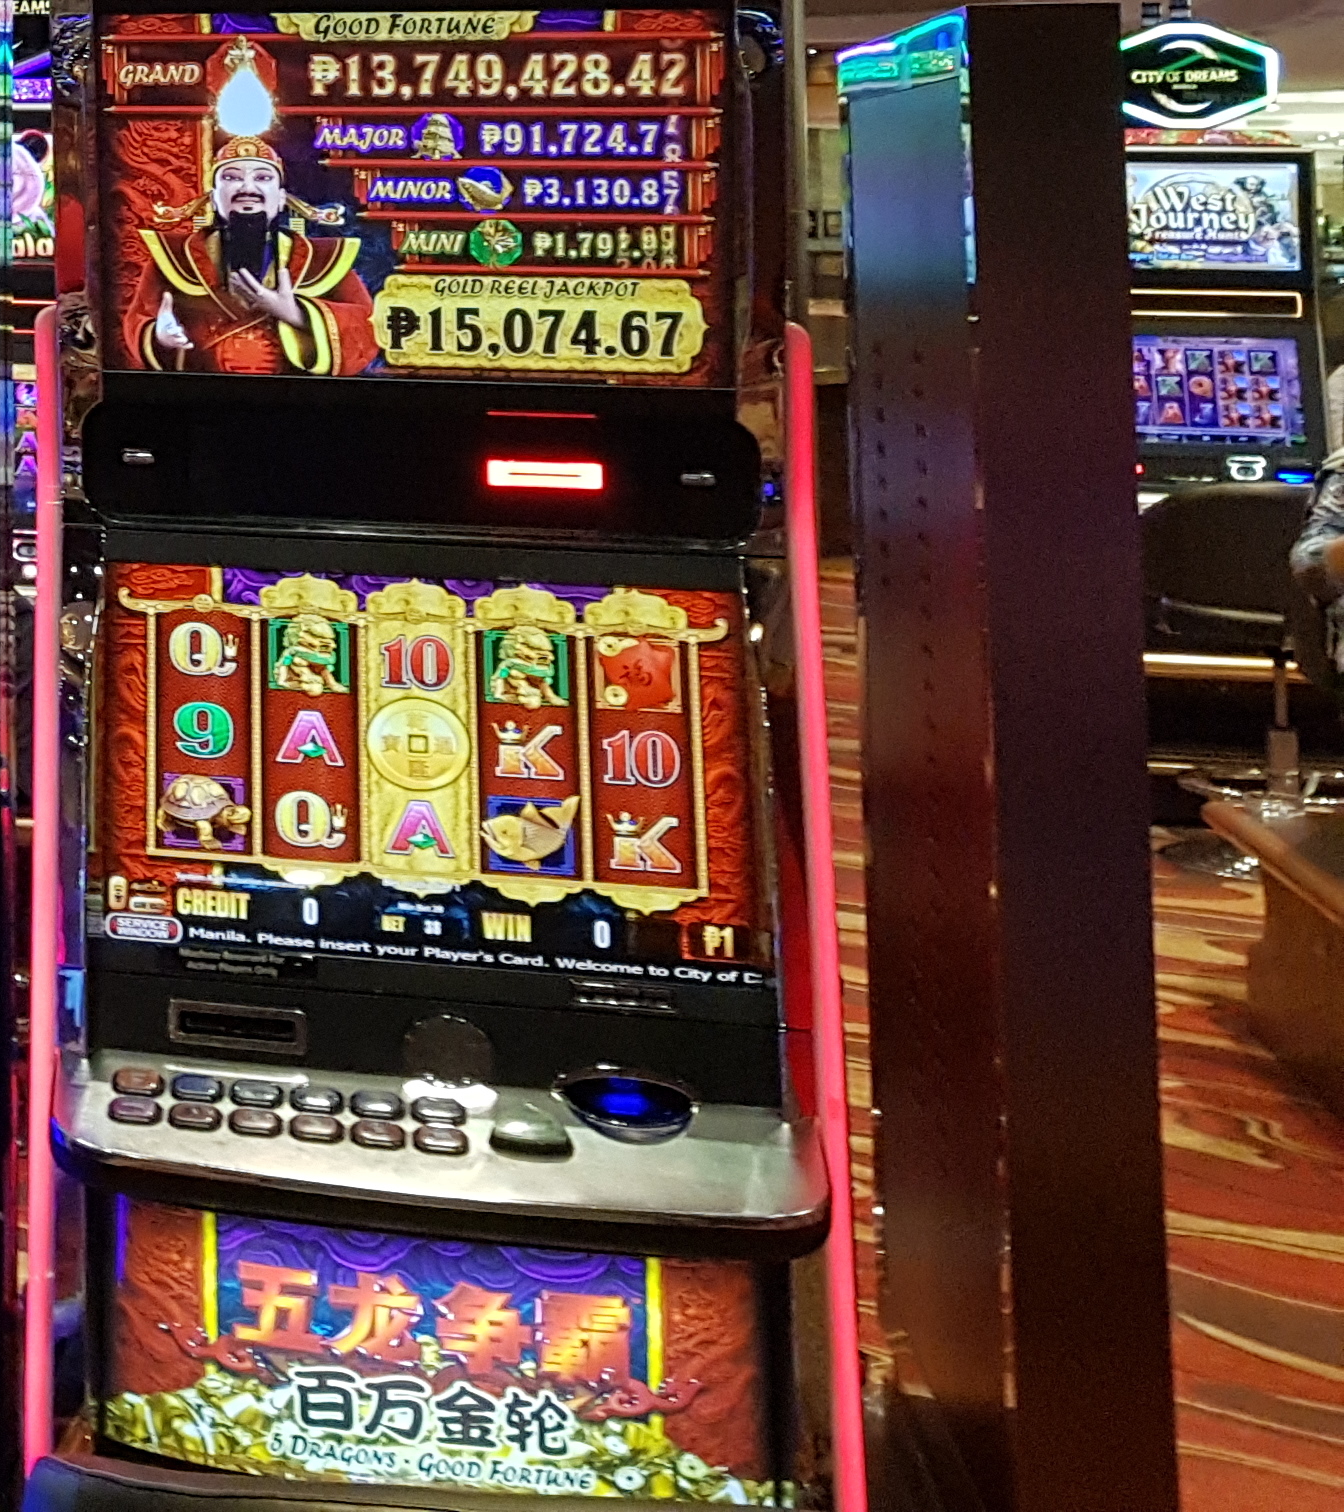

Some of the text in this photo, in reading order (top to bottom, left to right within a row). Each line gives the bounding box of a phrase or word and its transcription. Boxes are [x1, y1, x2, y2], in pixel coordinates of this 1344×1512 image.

[314, 13, 495, 39] GOOD FORTUNE
[118, 63, 202, 86] GRAND
[1130, 70, 1164, 83] CITY
[1184, 69, 1238, 82] DREAMS
[315, 125, 406, 151] MAJOR
[370, 179, 451, 201] MINOR
[1148, 186, 1236, 212] West
[1129, 204, 1255, 238] Journey
[401, 232, 463, 254] MINI
[434, 279, 641, 300] GOLD REEL JACKPOT
[387, 306, 683, 358] ₱15,074.67
[168, 621, 455, 691] Q 10
[173, 701, 681, 788] 9 A K 10
[274, 790, 681, 875] Q A K
[175, 888, 251, 921] CREDIT
[302, 897, 320, 925] 0
[481, 912, 532, 943] WIN
[592, 920, 612, 949] 0
[701, 926, 735, 959] ₱1
[188, 927, 251, 944] Manila.
[257, 933, 315, 949] Please
[319, 938, 372, 953] insert
[377, 945, 418, 957] your
[424, 946, 495, 964] Player's
[497, 954, 550, 969] Card.
[555, 957, 643, 976] Welcome
[647, 965, 670, 977] to
[673, 968, 712, 984] City
[716, 970, 739, 984] of
[229, 1259, 634, 1381] 五龙争霸
[293, 1370, 569, 1455] 百万金轮
[270, 1433, 595, 1489] 5 DRAGONS GOOD FORTUNE
